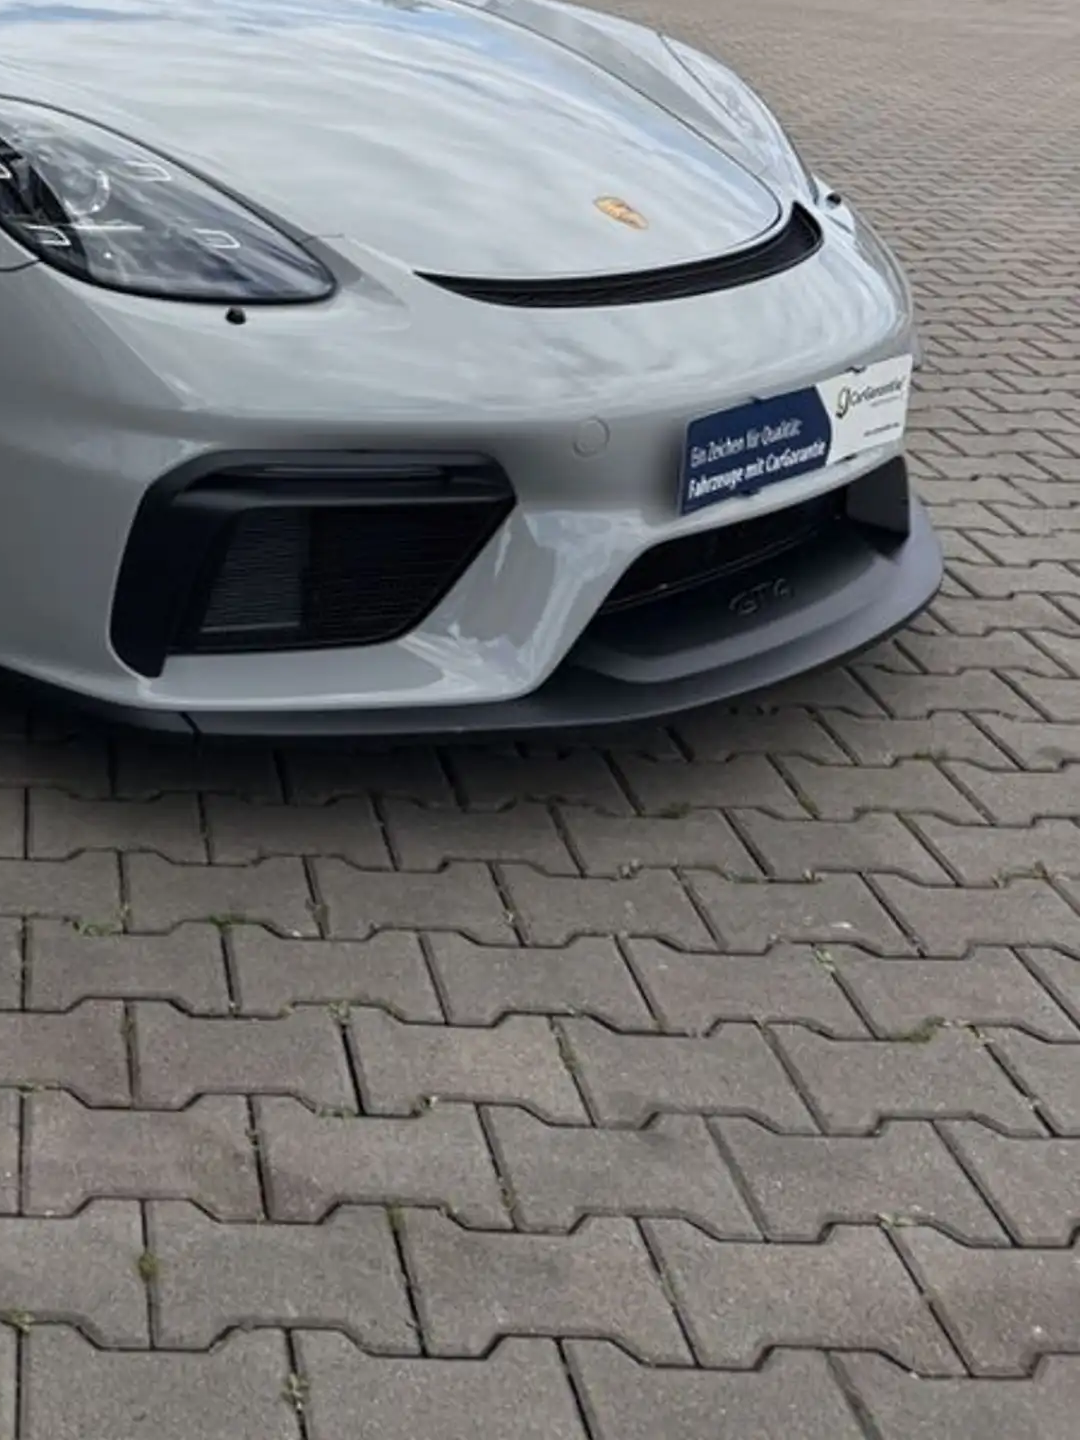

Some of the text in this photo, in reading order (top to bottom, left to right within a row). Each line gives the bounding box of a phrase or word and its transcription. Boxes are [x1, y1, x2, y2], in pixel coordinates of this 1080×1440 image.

[688, 439, 826, 499] Fahrzeuge mit CarGarantie
[707, 437, 745, 462] Zeichen
